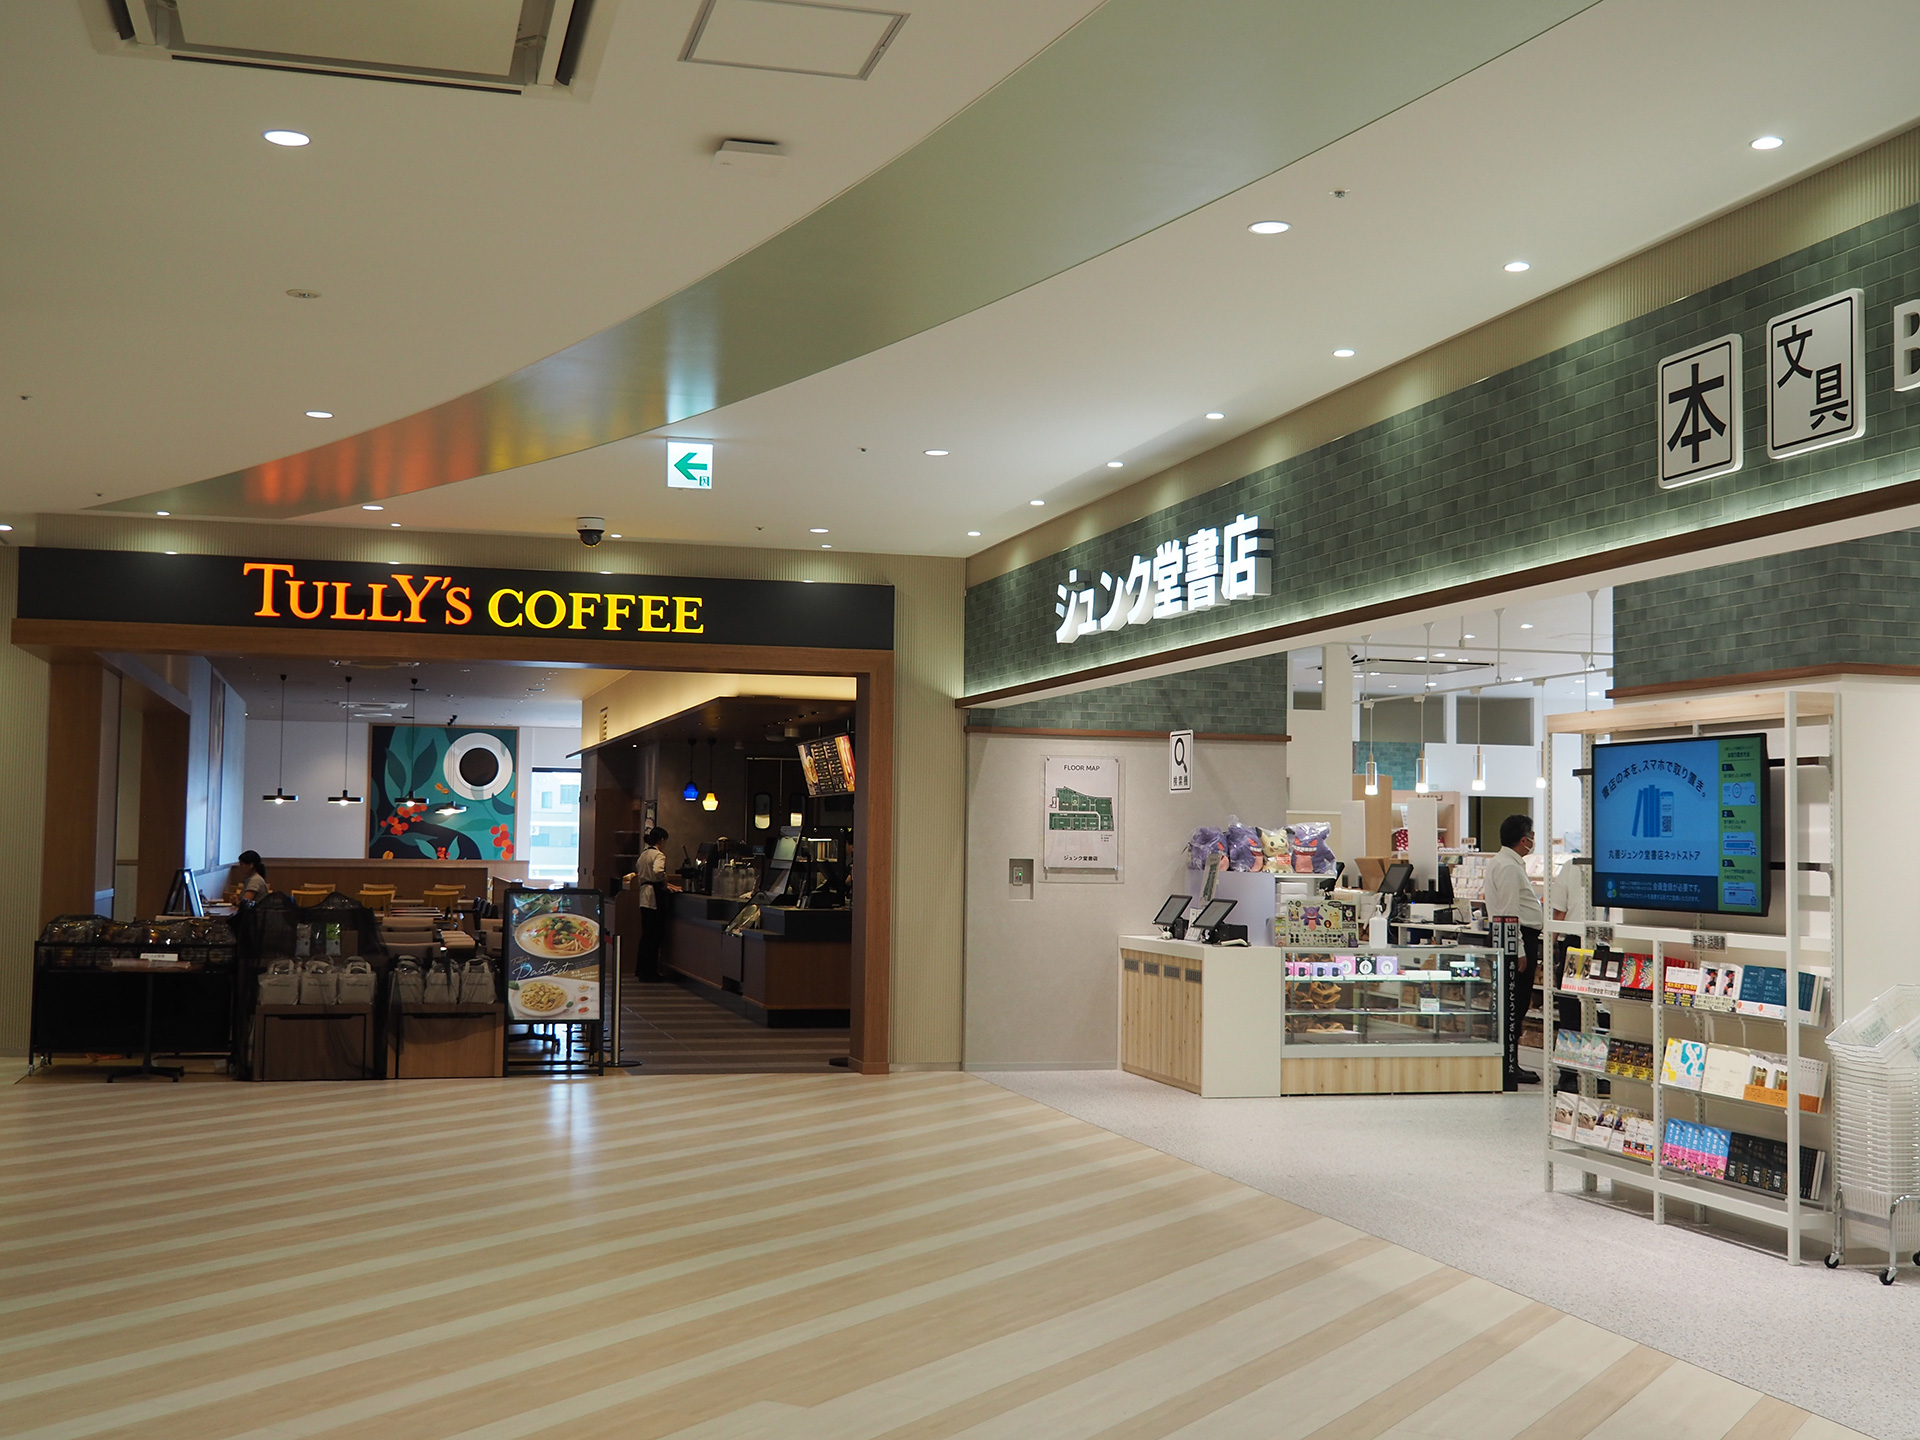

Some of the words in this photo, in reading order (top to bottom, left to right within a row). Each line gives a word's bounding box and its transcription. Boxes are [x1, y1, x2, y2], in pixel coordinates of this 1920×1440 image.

[1666, 363, 1727, 464] 本
[1776, 324, 1850, 430] 文具
[487, 588, 705, 634] COFFEE
[1055, 513, 1264, 644] ジュンク堂書店
[512, 959, 557, 983] Pasta
[1507, 924, 1517, 953] 出口
[1508, 960, 1516, 1073] ありがとうございました
